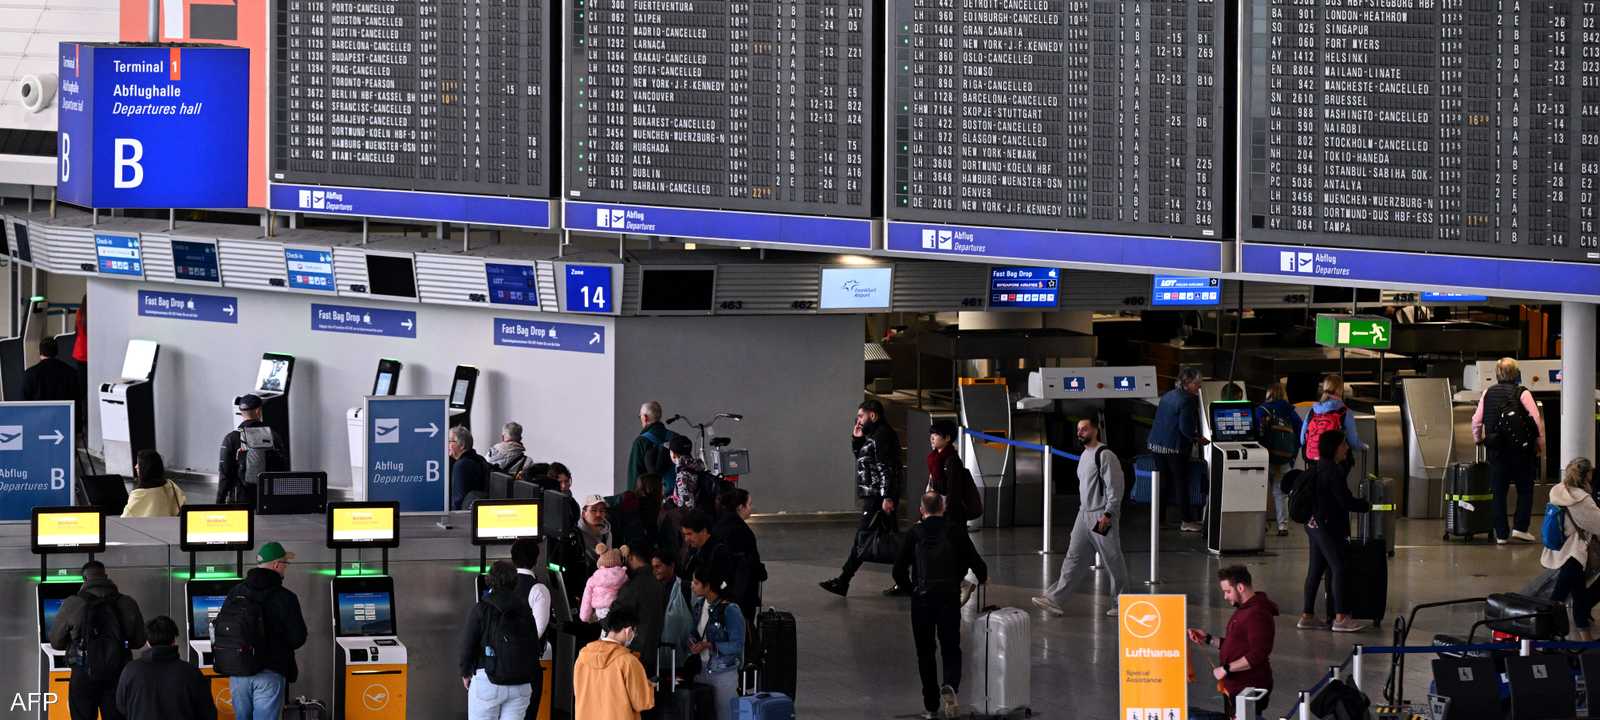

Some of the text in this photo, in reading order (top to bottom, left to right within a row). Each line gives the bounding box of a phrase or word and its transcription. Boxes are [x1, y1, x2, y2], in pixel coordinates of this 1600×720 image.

[633, 0, 694, 12] FUERTEVENTURA
[612, 13, 661, 24] 062 TAIPEH
[938, 11, 1058, 24] 960 EDINBURGH-CANCELLED
[1299, 9, 1407, 23] 901 LONDON-HEATHROW
[633, 26, 707, 38] MADRID-CANCELLED
[963, 25, 1023, 36] GRAN CANARIA
[1299, 24, 1369, 36] 025 SINGAPUR
[607, 38, 862, 57] 1292 LARNACA Z21
[963, 39, 1212, 58] NEW YORK-J.F.KENNEDY Z69
[1325, 39, 1380, 50] FORT MYERS
[633, 52, 707, 64] KRAKAU-CANCELLED
[963, 52, 1033, 64] OSLO-CANCELLED
[1294, 52, 1368, 64] 1412 HELSINKI
[113, 60, 177, 72] Terminal 1
[633, 65, 702, 77] SOFIA-CANCELLED
[963, 66, 993, 76] TROMSO
[1325, 67, 1401, 79] MAILAND-LINATE
[633, 78, 726, 90] NEW YORK-J.F.KENNEDY
[963, 79, 1033, 91] RIGA-CANCELLED
[1324, 81, 1428, 94] MANCHESTE-CANCELLED
[113, 84, 180, 99] Abflughalle
[611, 90, 675, 102] 492 VANCOUVER
[934, 92, 1058, 105] 1128 BARCELONA-CANCELLED
[1324, 95, 1368, 106] BRUESSEL
[112, 102, 202, 116] Departures hall
[633, 104, 656, 114] MALTA
[962, 106, 1043, 118] SKOPJE-STUTTGART
[1324, 109, 1428, 122] WASHINGTO-CANCELLED
[633, 117, 716, 129] BUKAREST-CANCELLED
[962, 120, 1043, 132] BOSTON-CANCELLED
[1298, 121, 1363, 134] 590 NAIROBI
[633, 130, 725, 142] MUENCHEN-WUERZBURG-N
[962, 133, 1048, 145] GLASGOW-CANCELLED
[611, 141, 670, 153] 206 HURGHADA
[1297, 135, 1428, 150] 802 STOCKHOLM-CANCELLED
[62, 133, 70, 182] B
[938, 145, 1038, 159] 043 NEW YORK-NEWARK
[1324, 151, 1390, 163] TOKIO-HANEDA
[114, 138, 144, 188] B
[633, 155, 652, 165] ALTA
[610, 167, 661, 178] 651 DUBLIN
[962, 160, 1053, 173] DORTMUND-KOELN HBF
[1324, 165, 1431, 179] ISTANBUL-SABIHA GOK.
[962, 173, 1063, 186] HAMBURG-MUENSTER-OSN
[1292, 179, 1362, 190] 5036 ANTALYA
[633, 181, 711, 193] BAHRAIN-CANCELLED
[938, 185, 992, 198] 181 DENVER
[326, 192, 342, 202] Abflug
[1324, 193, 1433, 207] MUENCHEN-WUERZBURG-N
[326, 202, 352, 210] Departures
[962, 200, 1062, 214] NEW YORK-J.F.KENNEDY
[626, 210, 644, 220] Abflug
[1324, 207, 1433, 221] DORTMUND-DUS HBF-ESS
[626, 222, 656, 230] Departures
[1297, 220, 1351, 232] 064 TAMPA
[954, 232, 973, 242] Abflug
[954, 243, 986, 252] Departures
[1315, 254, 1336, 264] Abflug
[1315, 265, 1350, 275] Departures
[145, 296, 184, 308] Fast Bag Drop
[580, 286, 605, 308] 14
[720, 301, 743, 310] 463
[319, 310, 360, 323] Fast Bag Drop
[502, 324, 545, 338] Fast Bag Drop
[375, 462, 404, 472] Abflug
[426, 460, 439, 482] B
[0, 468, 27, 479] Abflug
[51, 468, 65, 490] B
[374, 474, 423, 484] Departures
[1125, 648, 1180, 658] Lufthansa
